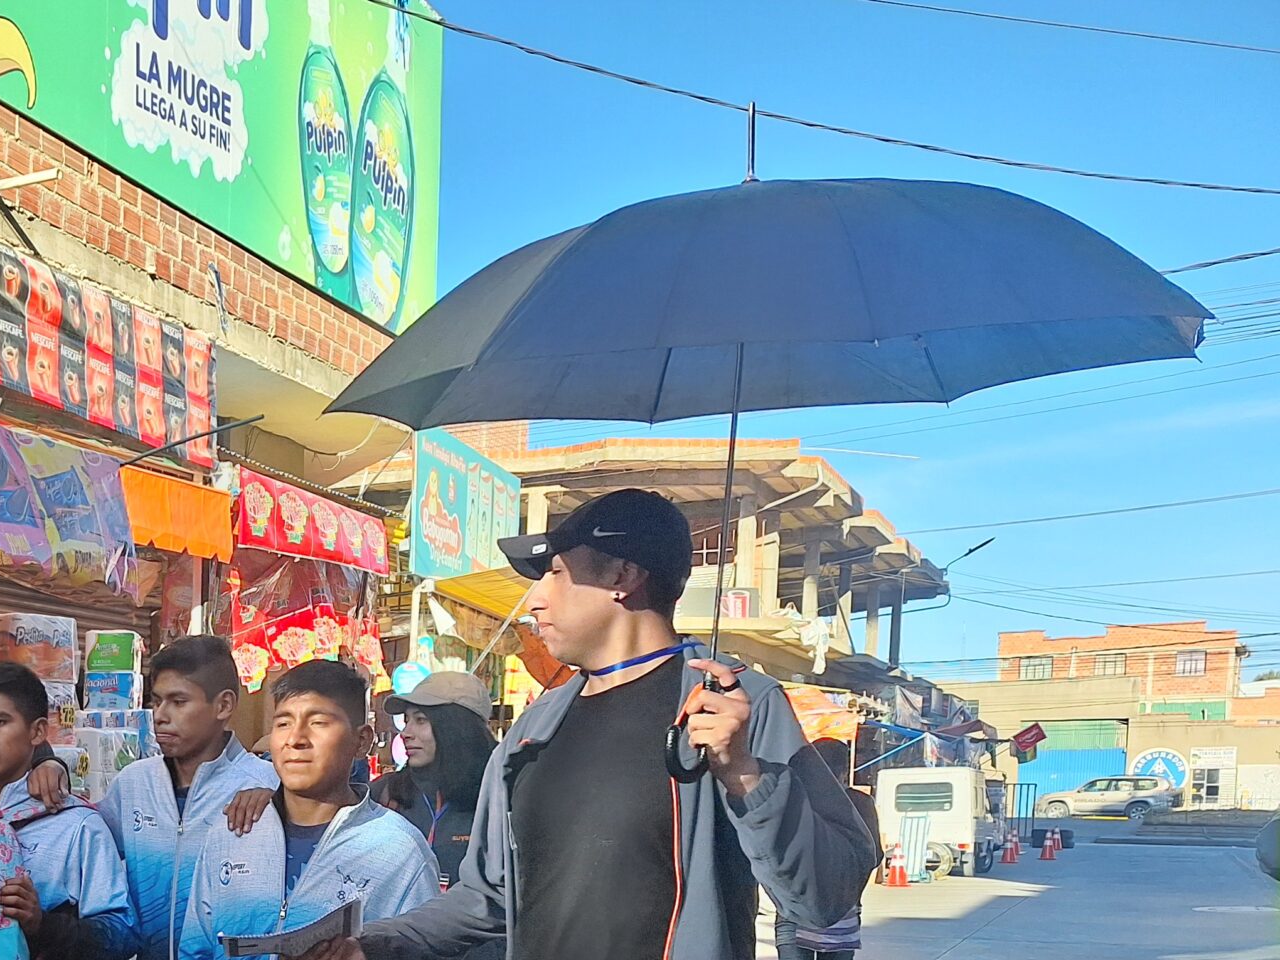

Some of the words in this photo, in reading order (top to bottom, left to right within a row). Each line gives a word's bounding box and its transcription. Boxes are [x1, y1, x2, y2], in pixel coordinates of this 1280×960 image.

[135, 42, 162, 90] LA
[167, 60, 232, 127] MUGRE
[135, 84, 176, 127] LLEGA
[179, 112, 189, 132] A
[191, 115, 207, 140] SU
[209, 121, 231, 153] FIN!
[306, 120, 346, 163] Pulpin
[363, 140, 406, 215] Pulpin
